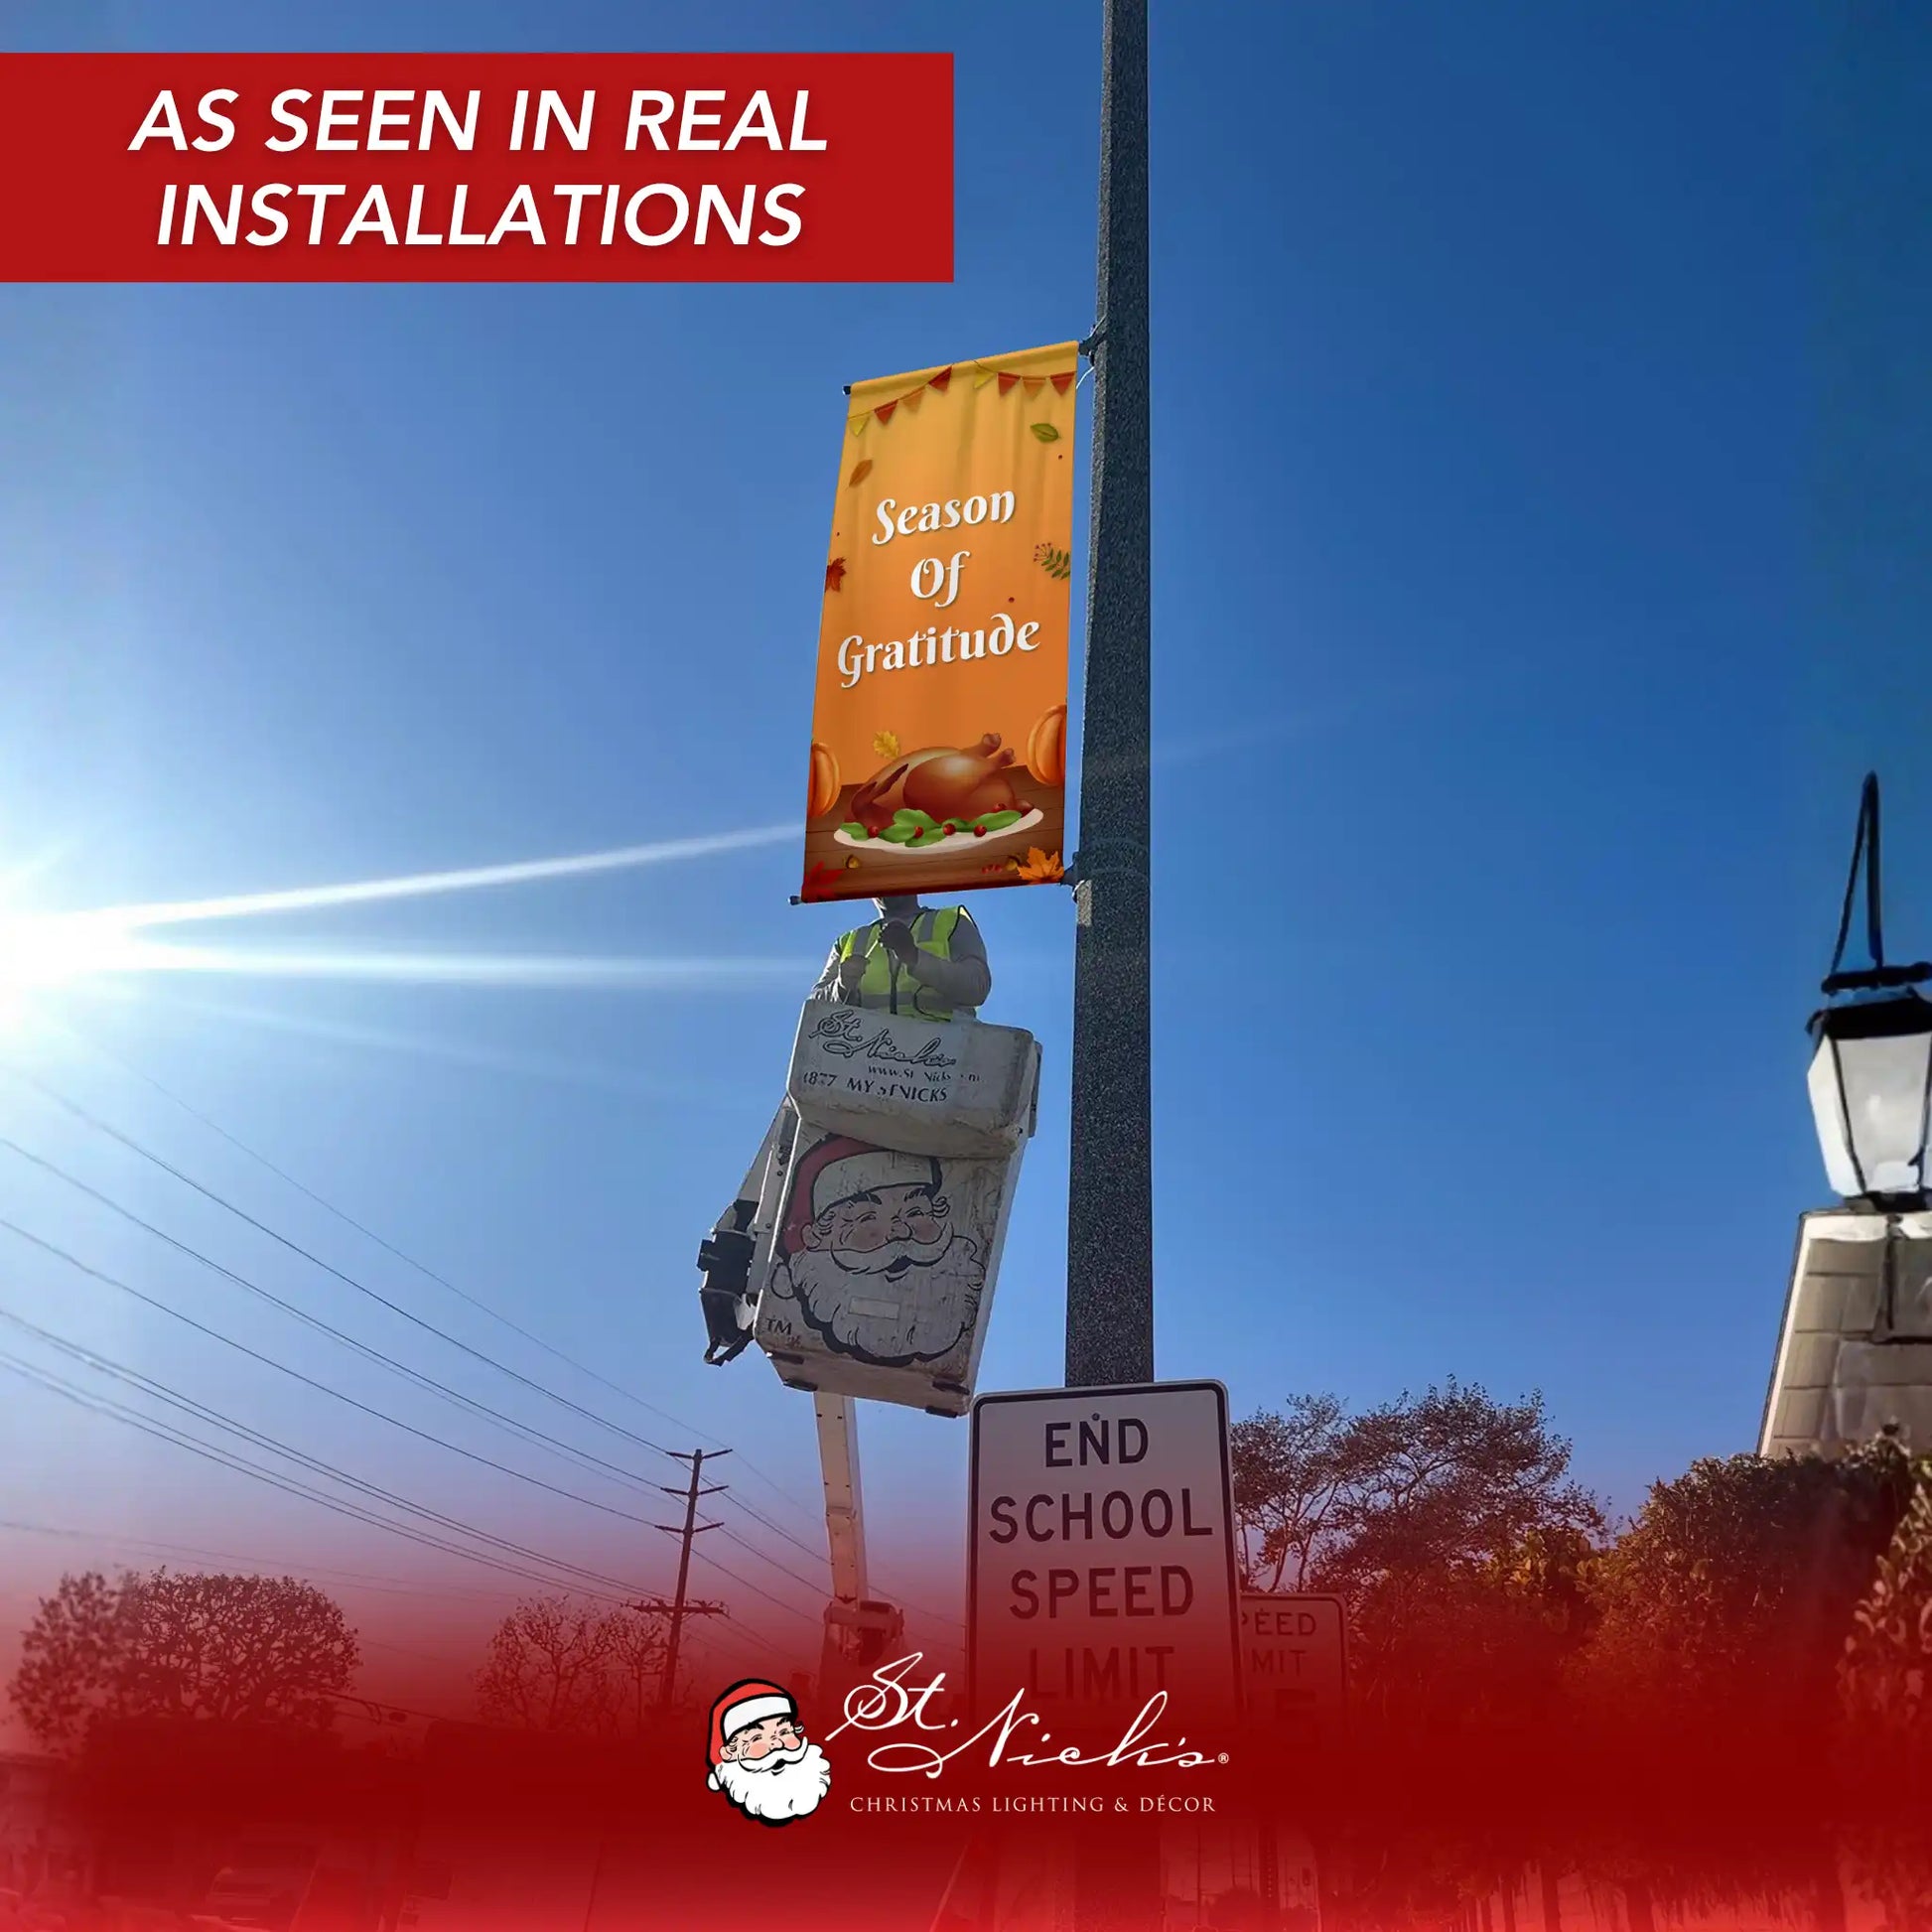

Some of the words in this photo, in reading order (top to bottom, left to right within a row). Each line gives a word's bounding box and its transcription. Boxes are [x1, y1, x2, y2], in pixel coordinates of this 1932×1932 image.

[871, 489, 1016, 546] Season
[909, 550, 971, 608] Of
[837, 613, 1040, 689] Gratitude
[847, 1077, 876, 1094] MY
[765, 1317, 792, 1335] TM
[1045, 1418, 1150, 1468] END
[989, 1488, 1213, 1544] SCHOOL
[1010, 1565, 1193, 1620] SPEED
[1241, 1609, 1317, 1637] EED
[1029, 1645, 1175, 1701] LIMIT
[1251, 1648, 1308, 1678] MIT
